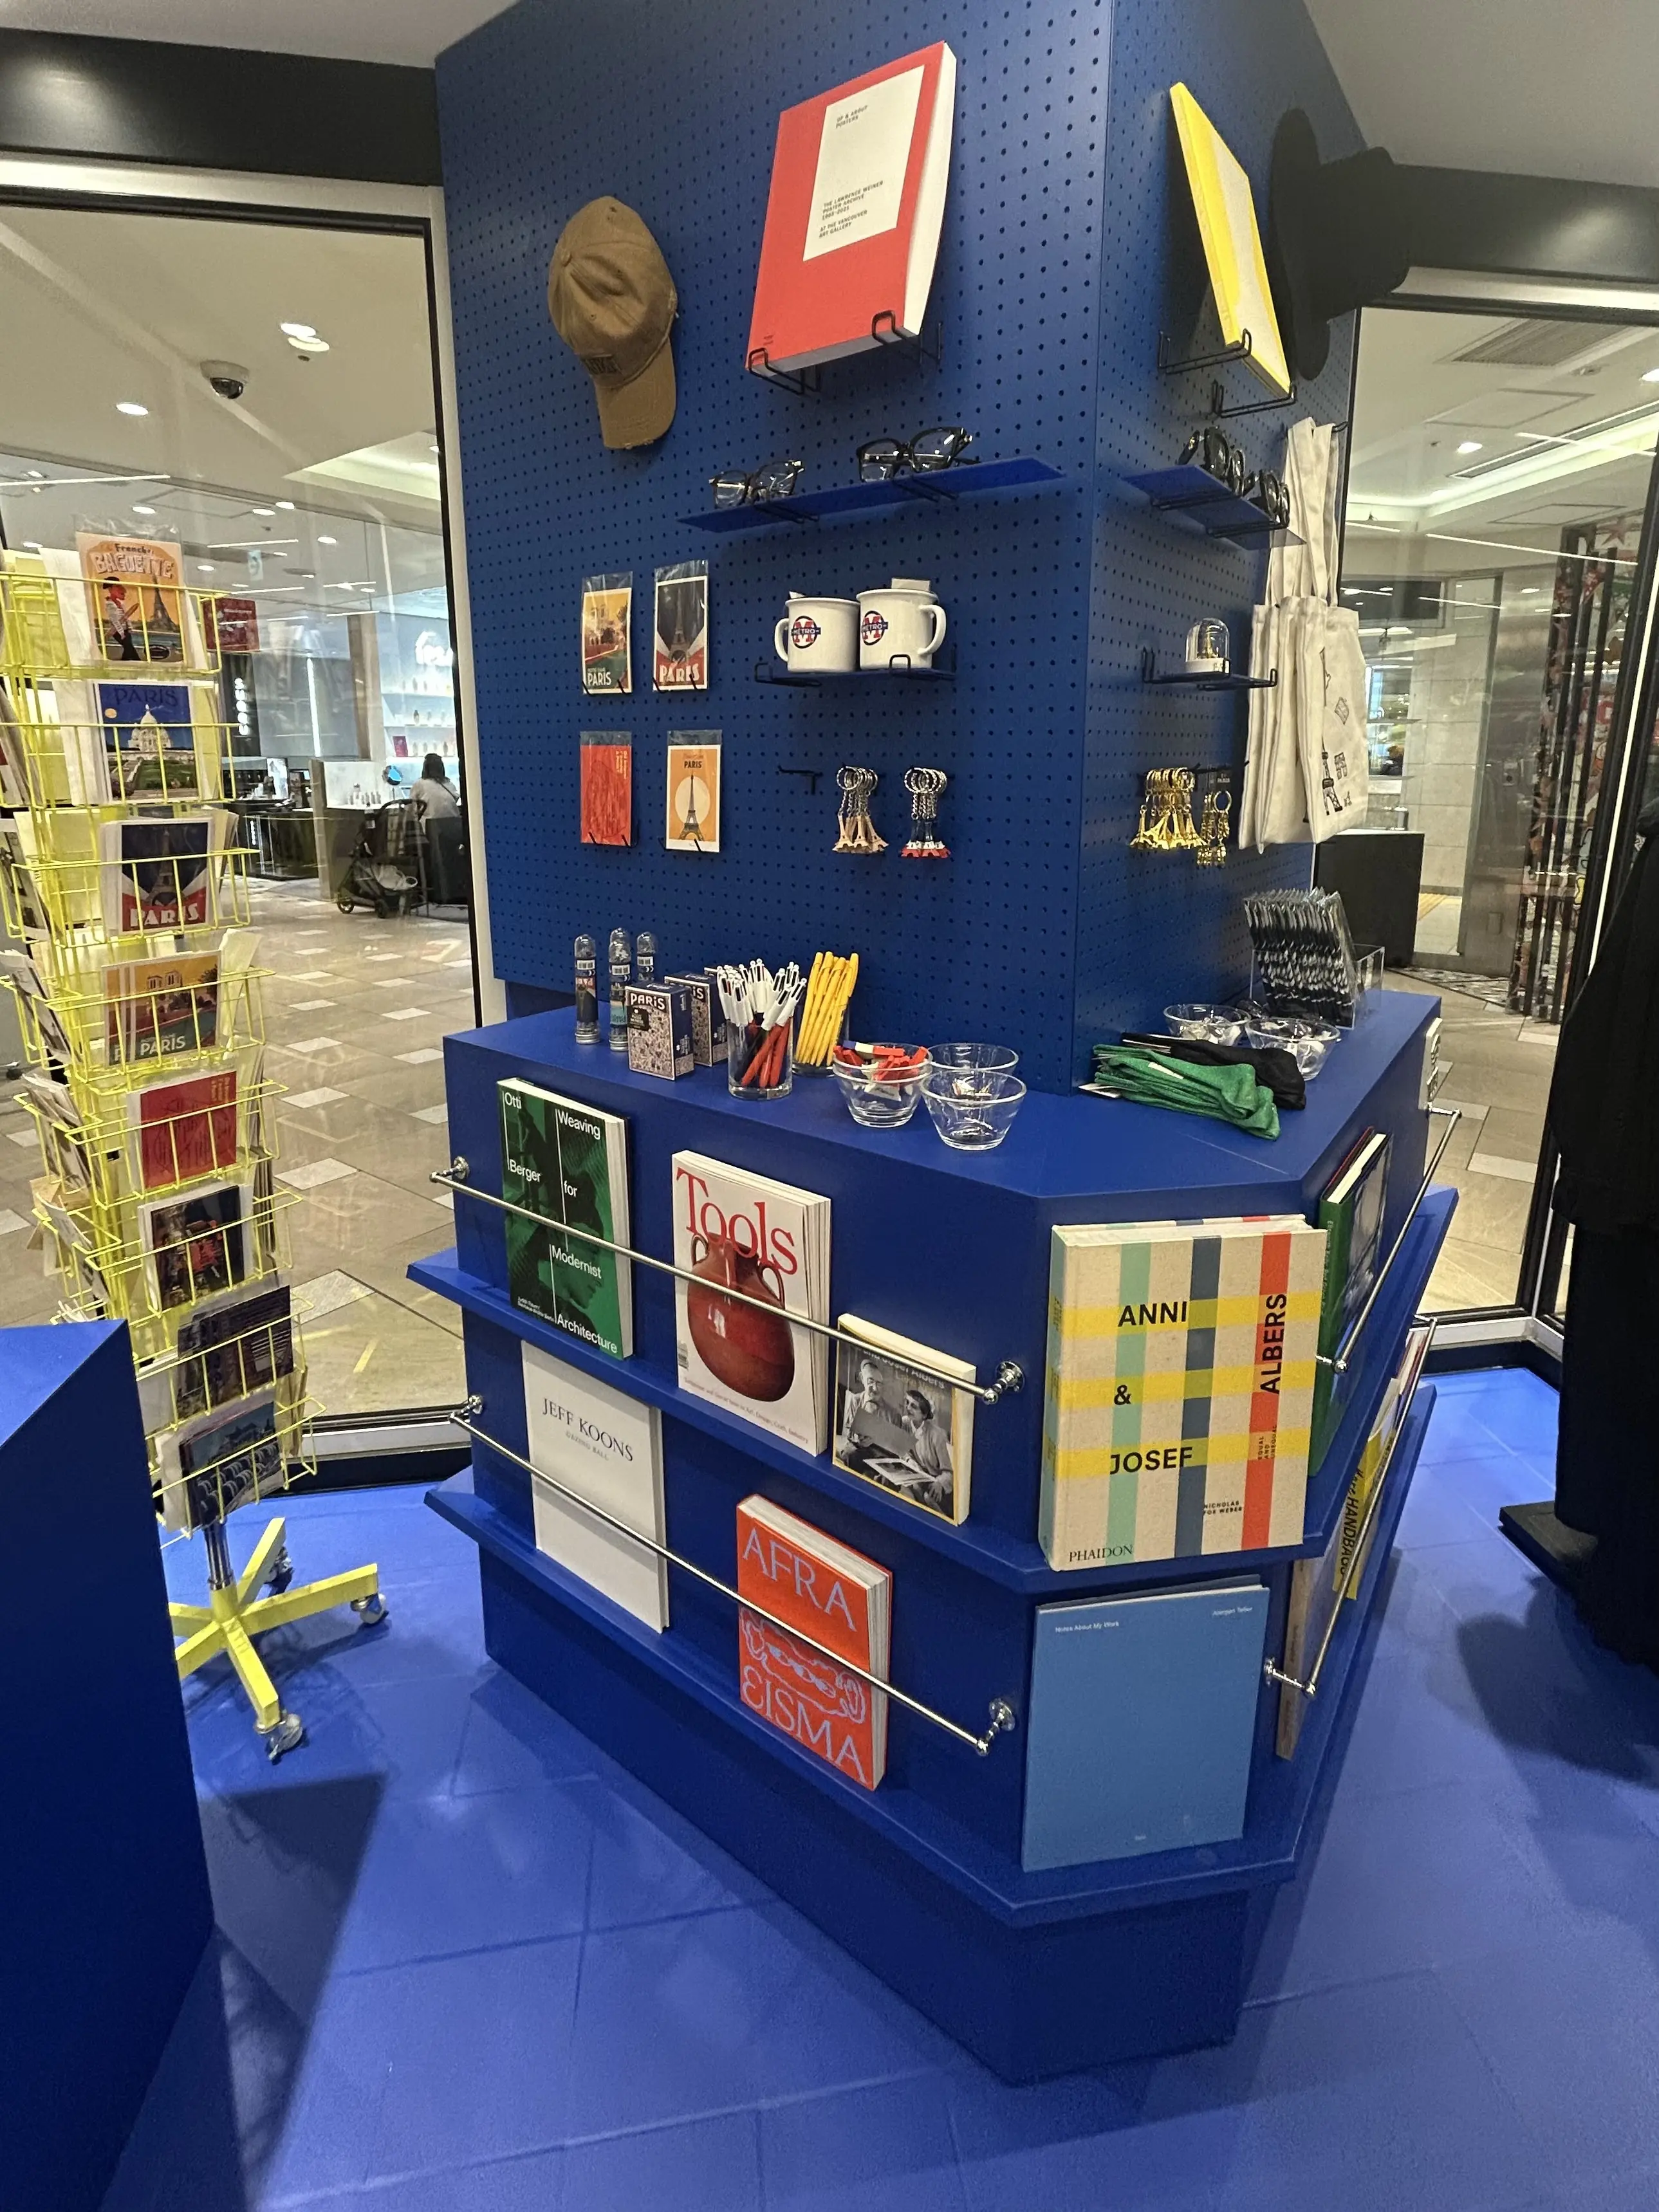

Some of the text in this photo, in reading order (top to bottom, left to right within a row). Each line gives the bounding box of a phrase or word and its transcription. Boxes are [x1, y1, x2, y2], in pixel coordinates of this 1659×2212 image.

[834, 189, 861, 204] LAWRENCE
[863, 180, 883, 192] WEINER
[830, 221, 852, 234] GALLERY
[839, 209, 867, 225] VANCOUVER
[91, 553, 174, 579] BAGUETTE
[588, 672, 611, 686] PARIS
[659, 663, 700, 683] PARIS
[115, 686, 179, 708] PARIS
[505, 1092, 522, 1109] Otti
[558, 1110, 601, 1140] Weaving
[509, 1159, 541, 1183] Berger
[564, 1181, 578, 1197] for
[676, 1167, 798, 1275] Tools
[551, 1245, 602, 1279] Modernist
[1118, 1301, 1187, 1327] ANNI
[557, 1313, 617, 1354] Architecture
[1260, 1293, 1287, 1395] ALBERS
[1113, 1385, 1131, 1406] &
[542, 1398, 633, 1462] JEFF KOONS
[1109, 1446, 1193, 1475] JOSEF
[1203, 1500, 1240, 1509] NICHOLAS
[1069, 1545, 1133, 1563] PHAIDON
[743, 1527, 858, 1632] AFRA
[742, 1665, 867, 1785] EISMA
